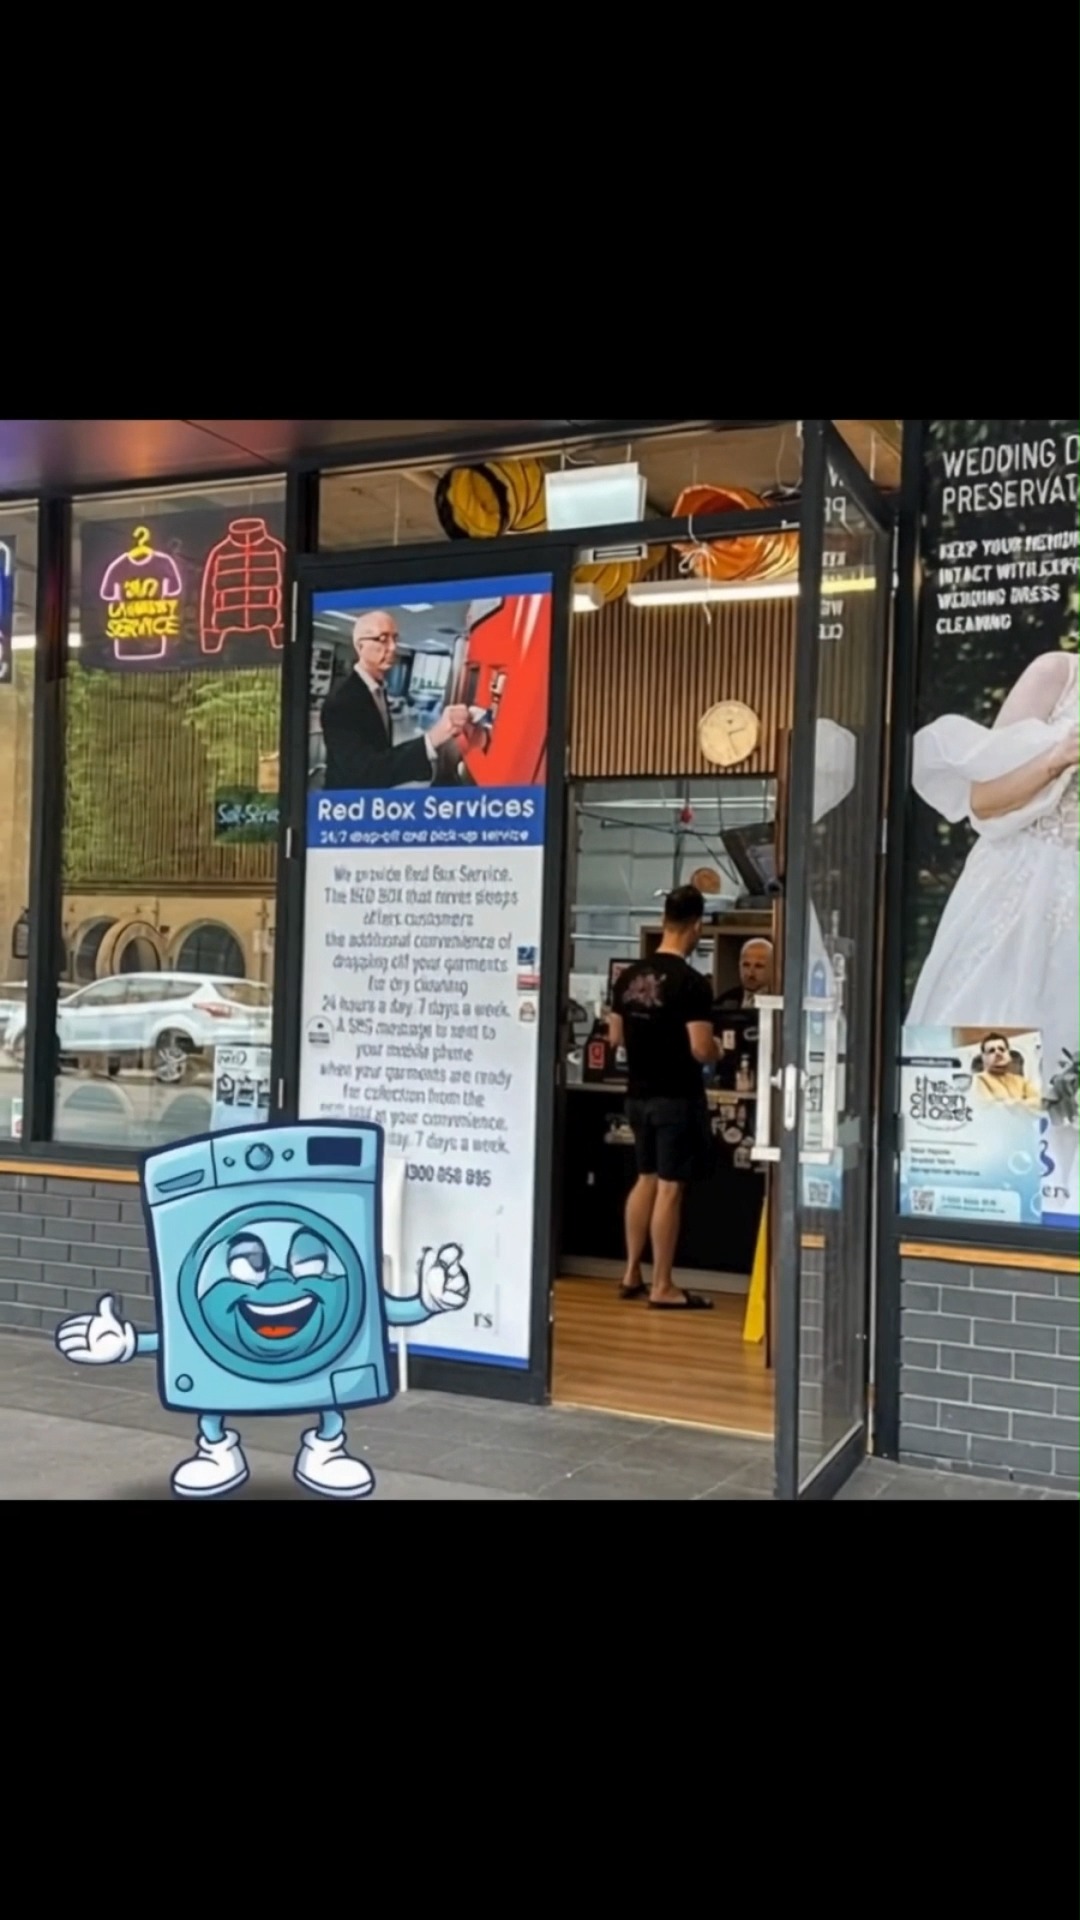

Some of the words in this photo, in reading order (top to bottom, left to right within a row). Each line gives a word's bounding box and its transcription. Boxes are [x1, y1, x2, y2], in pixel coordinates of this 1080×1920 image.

[942, 438, 1056, 479] WEDDING
[939, 540, 978, 560] KEEP
[982, 534, 1022, 557] YOUR
[939, 565, 993, 586] INTACT
[996, 561, 1036, 580] WITH
[937, 588, 1006, 610] WEDDING
[1010, 583, 1060, 605] DRESS
[106, 617, 179, 638] SERVICE
[936, 614, 1012, 635] CLEANING
[318, 798, 364, 821] Red
[371, 797, 416, 820] Box
[423, 795, 534, 819] Services
[350, 830, 400, 844] drop-off
[402, 830, 428, 843] and
[430, 829, 478, 843] pick-up
[481, 830, 529, 841] service
[333, 867, 351, 882] We
[355, 867, 401, 883] provide
[405, 866, 429, 882] Red
[433, 866, 456, 882] Box
[459, 865, 513, 882] Service.
[325, 888, 347, 905] The
[406, 889, 431, 905] that
[435, 891, 472, 906] never
[363, 910, 401, 927] offers
[404, 912, 474, 927] customers
[326, 932, 345, 948] the
[348, 932, 411, 948] additional
[413, 934, 494, 950] convenience
[498, 932, 512, 949] of
[332, 954, 388, 974] dropping
[391, 953, 409, 970] off
[412, 957, 441, 974] your
[444, 957, 508, 974] garments
[368, 976, 386, 992] for
[390, 976, 410, 995] dry
[414, 976, 468, 997] cleaning
[322, 995, 337, 1012] 24
[339, 996, 375, 1013] hours
[378, 1001, 387, 1014] a
[418, 997, 426, 1014] 7
[428, 998, 459, 1019] days
[462, 1003, 471, 1016] a
[336, 1017, 345, 1034] A
[375, 1023, 433, 1041] message
[450, 1024, 479, 1040] sent
[482, 1024, 496, 1040] to
[356, 1045, 383, 1059] your
[386, 1043, 429, 1059] mobile
[433, 1045, 474, 1063] phone
[320, 1062, 351, 1077] when
[355, 1065, 382, 1081] your
[385, 1066, 447, 1083] garments
[450, 1069, 471, 1084] are
[474, 1069, 513, 1091] ready
[343, 1083, 361, 1099] for
[364, 1085, 426, 1104] collection
[428, 1088, 461, 1106] from
[463, 1090, 486, 1108] the
[390, 1110, 419, 1126] your
[414, 1130, 424, 1147] 7
[426, 1132, 458, 1154] days
[461, 1139, 469, 1152] a
